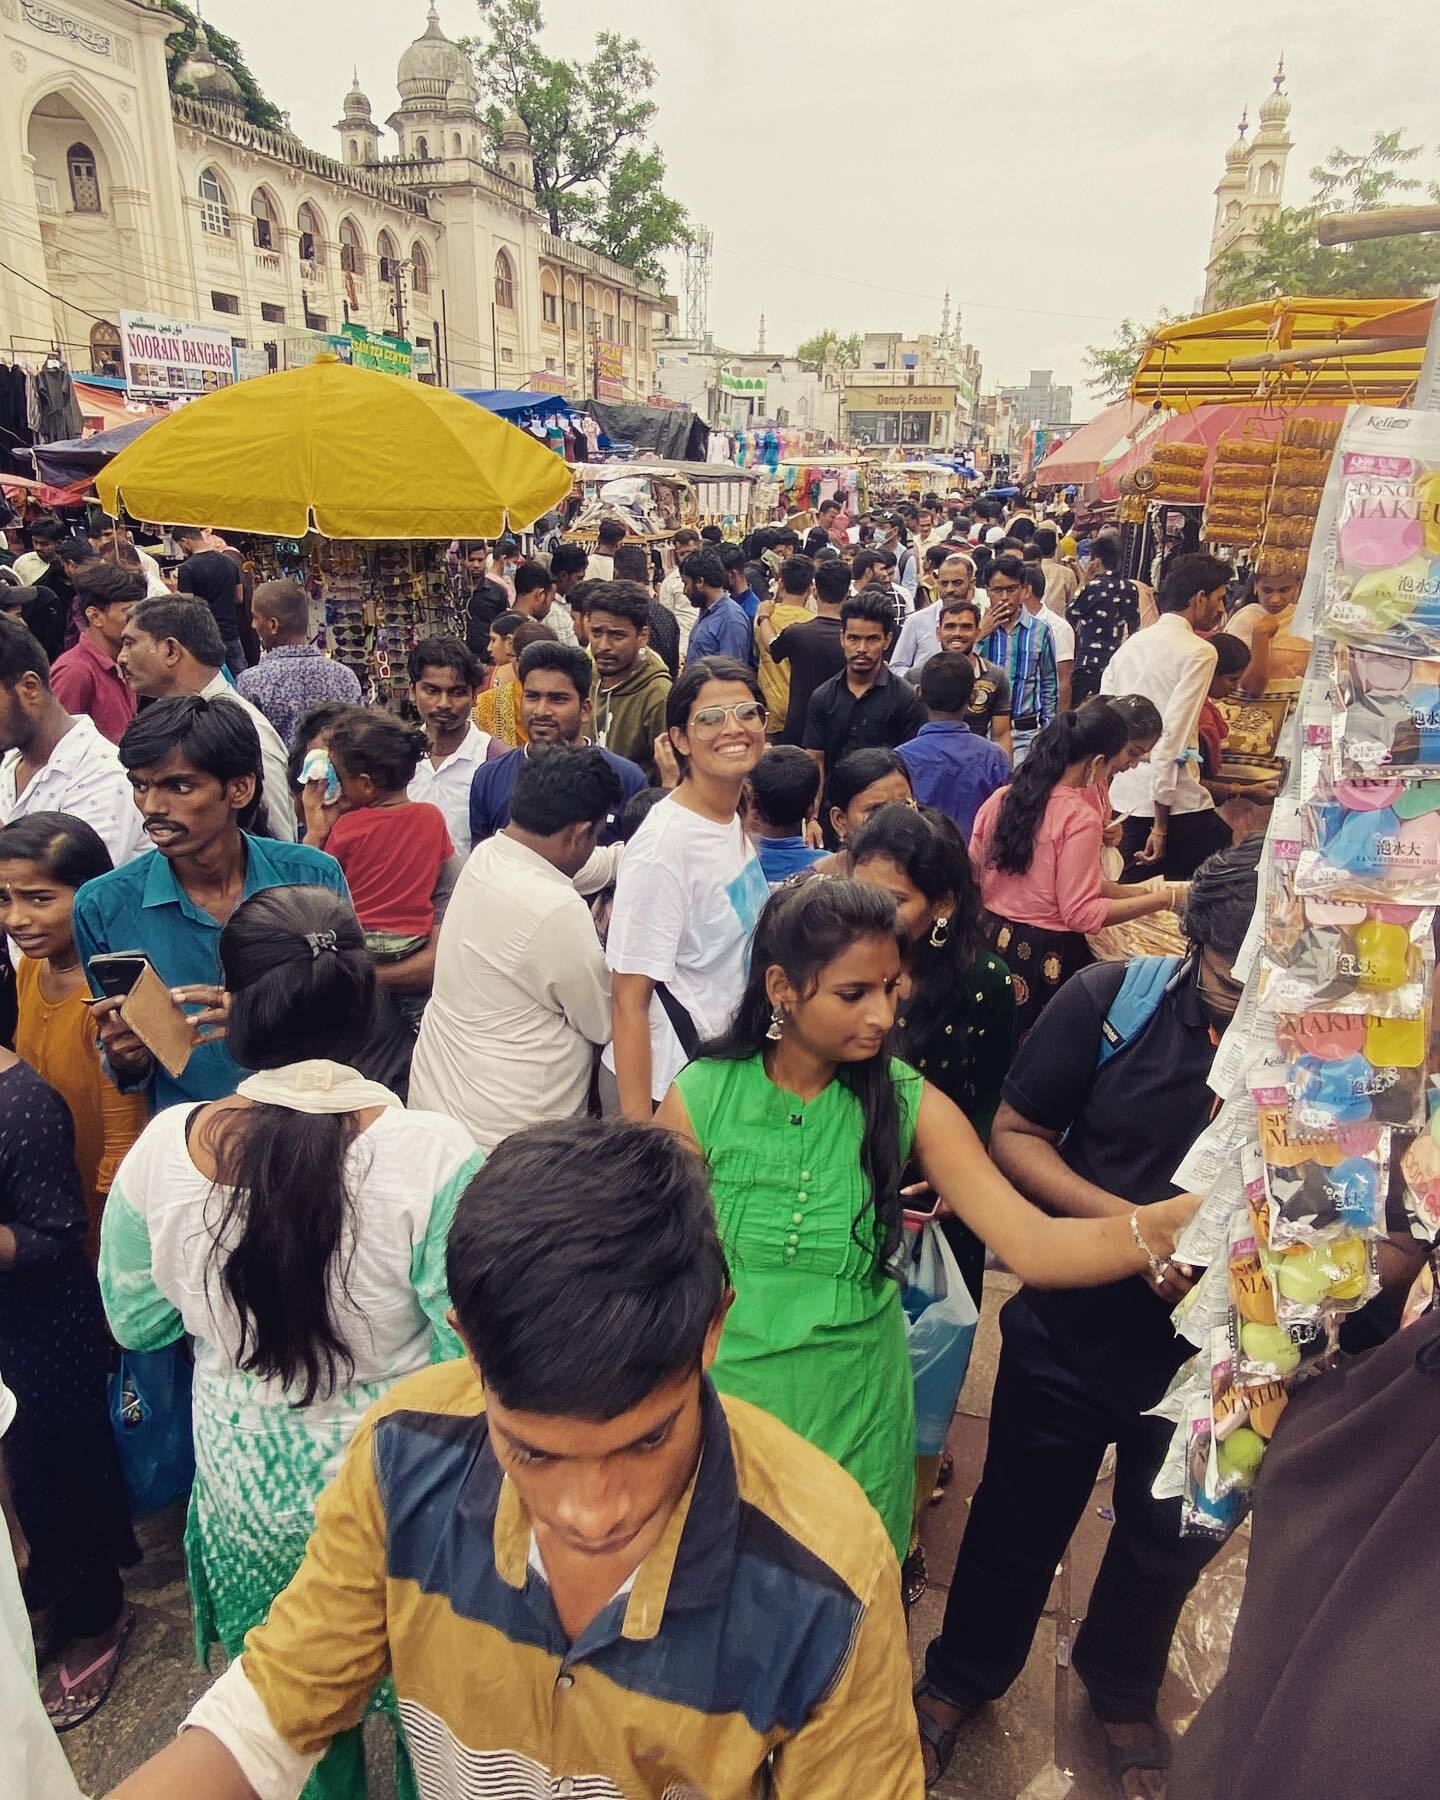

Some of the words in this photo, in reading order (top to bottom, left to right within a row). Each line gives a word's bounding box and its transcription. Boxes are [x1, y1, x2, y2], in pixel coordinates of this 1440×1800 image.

[128, 333, 180, 361] NOORAIN
[182, 340, 232, 367] BANGLES
[908, 394, 942, 405] Fashion
